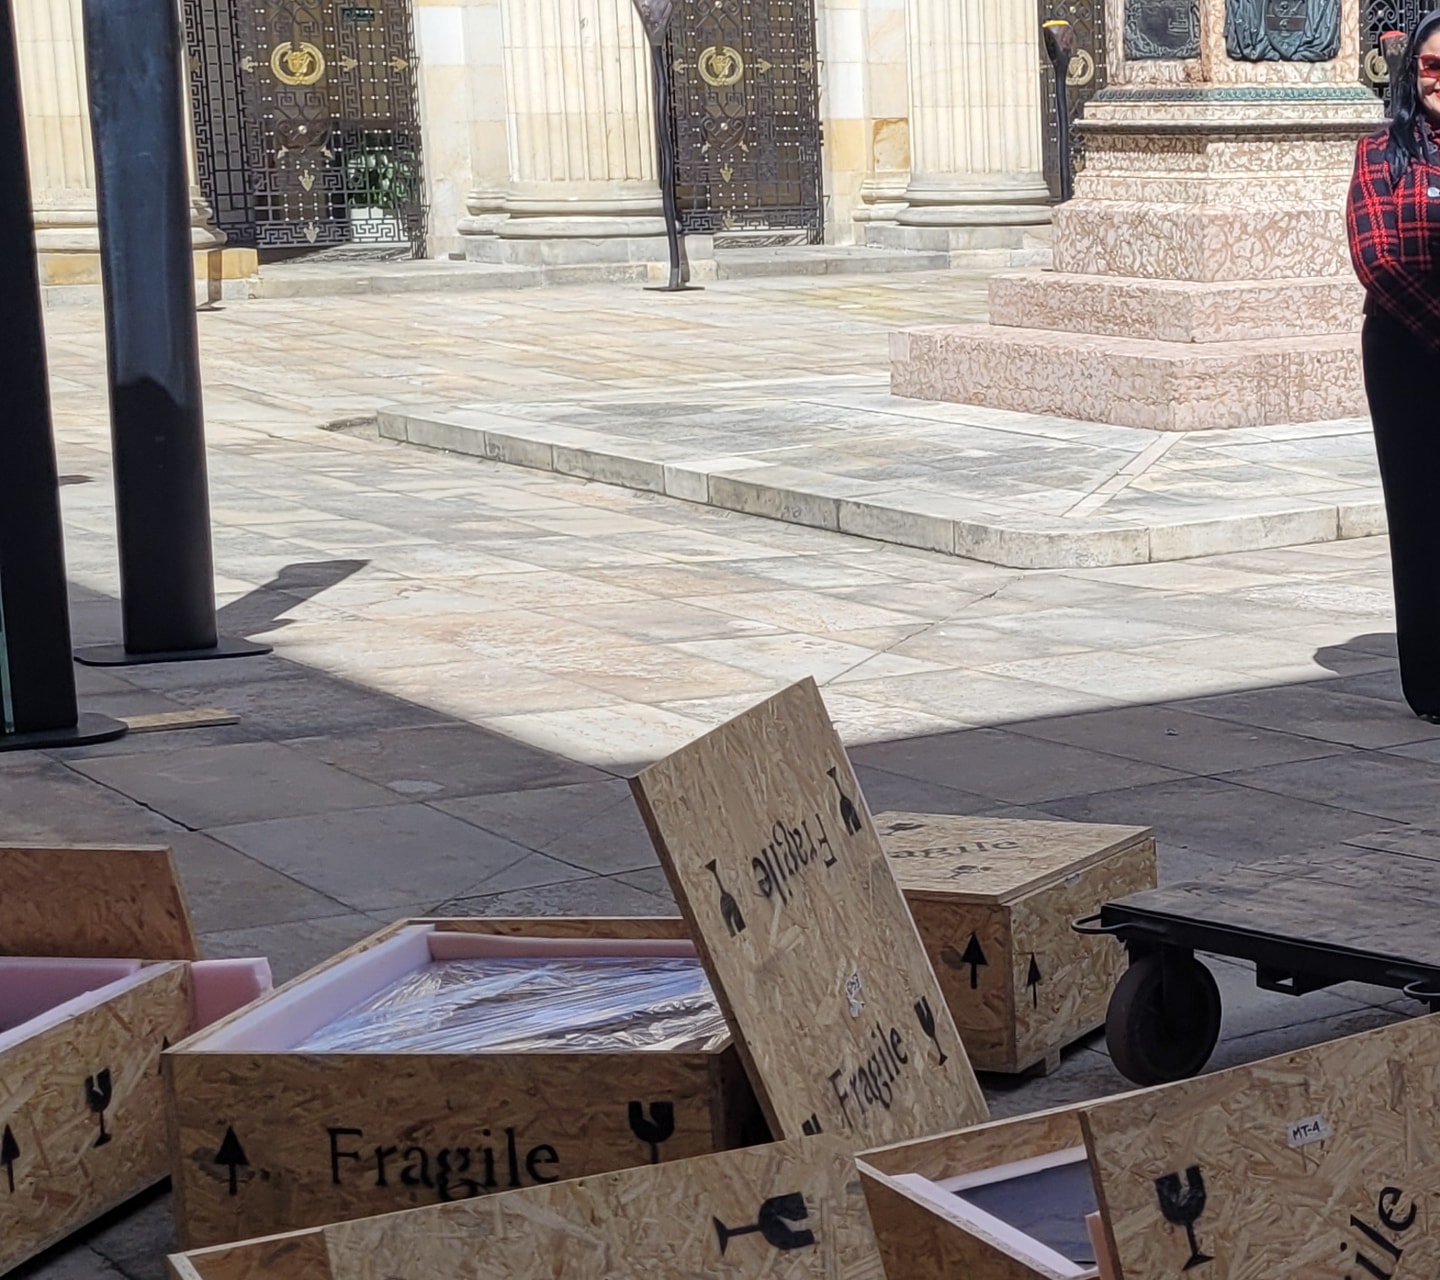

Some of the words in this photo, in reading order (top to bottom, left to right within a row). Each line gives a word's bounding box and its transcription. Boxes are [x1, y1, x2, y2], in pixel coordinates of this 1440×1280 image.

[752, 813, 838, 905] Fragile
[827, 1021, 909, 1133] Fragile
[326, 1126, 560, 1201] Fragile
